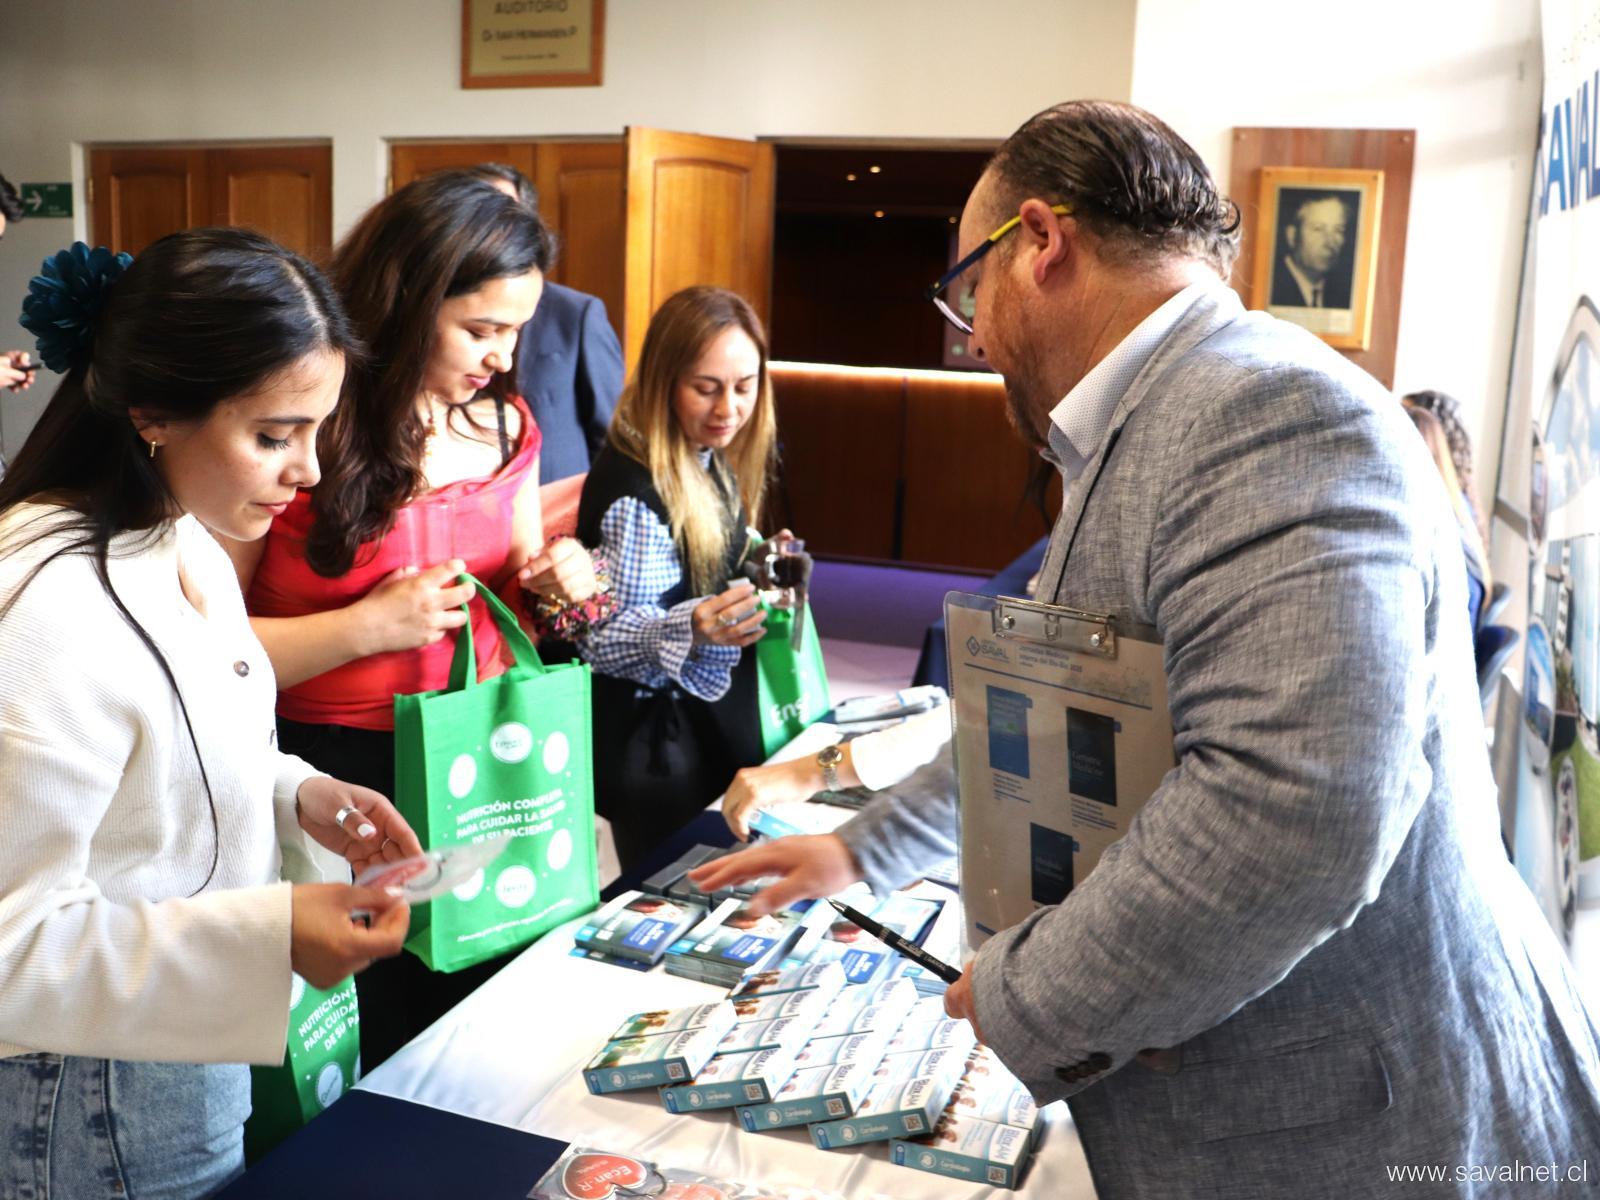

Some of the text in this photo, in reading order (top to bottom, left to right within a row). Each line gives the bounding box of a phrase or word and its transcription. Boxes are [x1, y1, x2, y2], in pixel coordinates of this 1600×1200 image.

[479, 813, 522, 830] CUIDAR
[298, 988, 351, 1037] NUTRICIÓN
[304, 1025, 327, 1051] PARA
[324, 1033, 337, 1051] DE
[335, 1022, 347, 1039] SU
